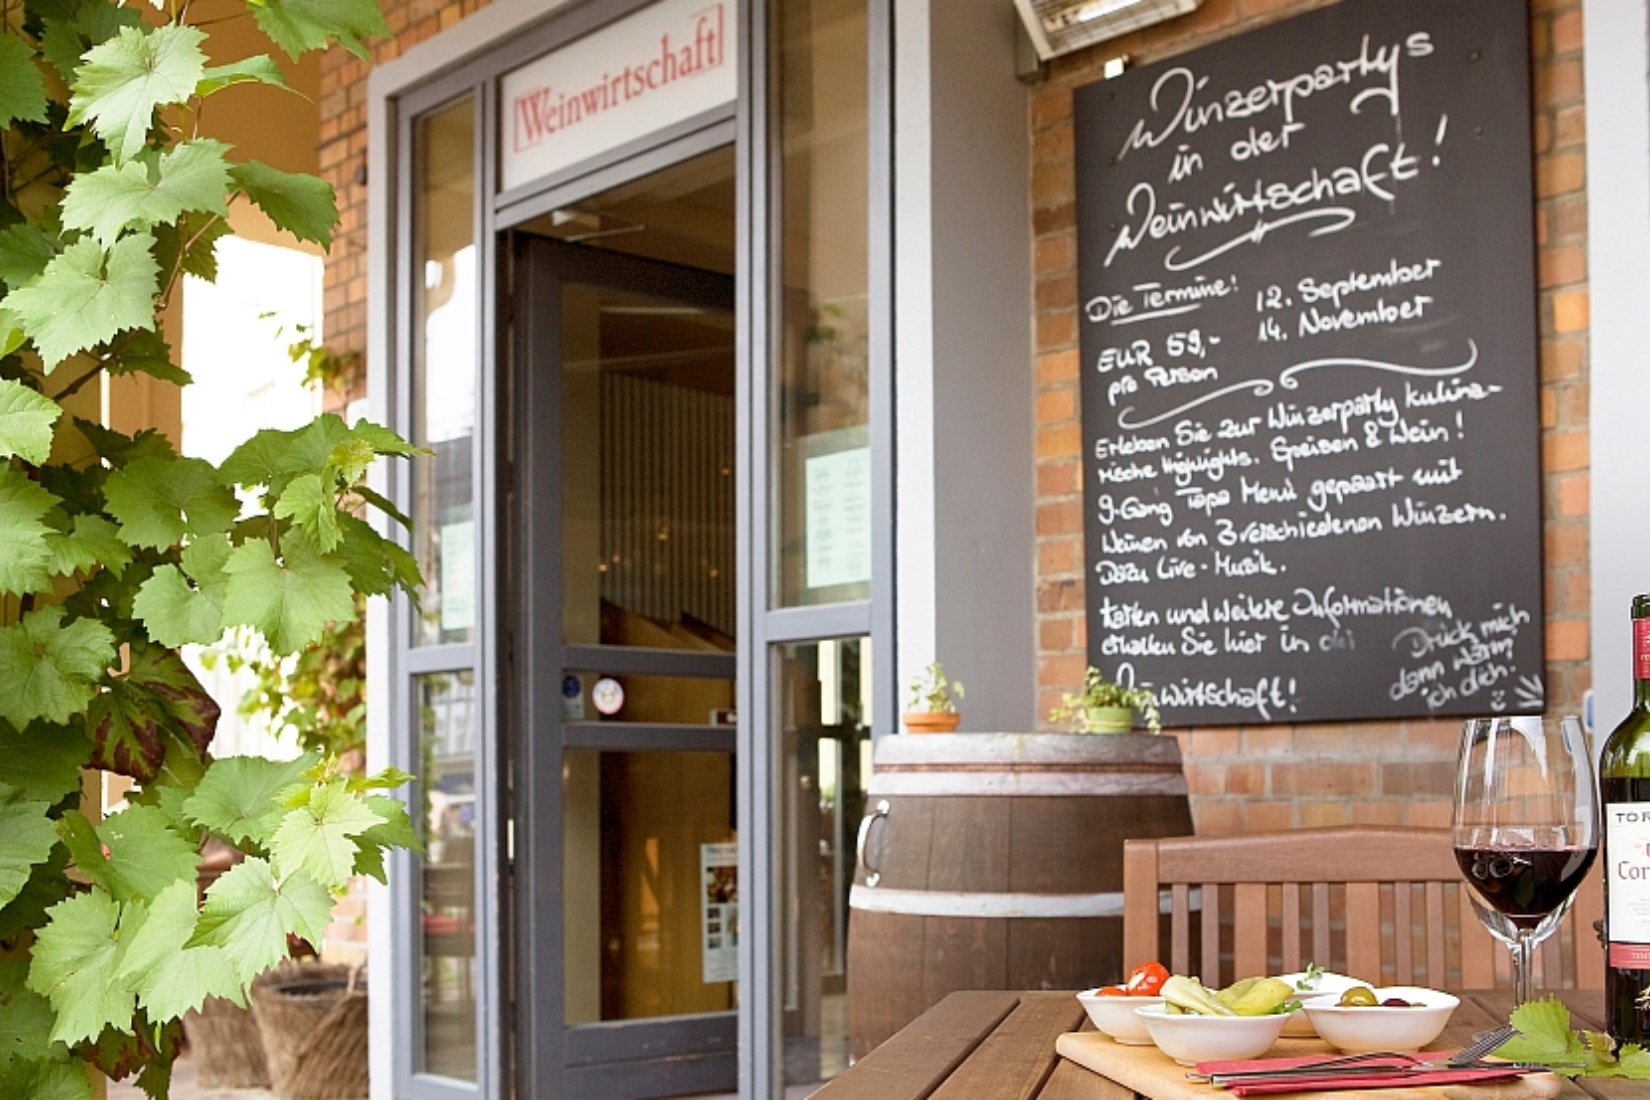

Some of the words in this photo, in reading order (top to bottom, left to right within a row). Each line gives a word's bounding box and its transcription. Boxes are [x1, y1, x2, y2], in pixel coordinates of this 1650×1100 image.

[516, 16, 717, 143] Weinwirtschaft
[1168, 145, 1203, 184] in
[1230, 122, 1306, 161] der
[1085, 294, 1134, 322] Die
[1256, 285, 1292, 312] 12.
[1297, 259, 1441, 306] September
[1257, 316, 1288, 342] 14.
[1298, 294, 1434, 337] November
[1097, 340, 1153, 372] EUR
[1108, 375, 1138, 406] pro
[1144, 365, 1218, 393] Person
[1095, 435, 1170, 459] Erleben
[1174, 419, 1212, 446] Sie
[1267, 386, 1399, 434] Winzerparty
[1097, 460, 1158, 484] rische
[1270, 436, 1358, 472] Speisen
[1363, 420, 1383, 448] &
[1306, 467, 1404, 512] gepaart
[1412, 456, 1463, 485] mit
[1102, 529, 1168, 554] Weinen
[1177, 527, 1208, 547] von
[1239, 510, 1383, 544] verschiedenen
[1095, 560, 1149, 586] Dazu
[1166, 597, 1211, 625] und
[1214, 591, 1290, 622] weitere
[1292, 586, 1453, 629] Informationen
[1480, 603, 1531, 637] mich
[1101, 633, 1176, 656] erhalten
[1181, 626, 1218, 656] Sie
[1224, 627, 1267, 653] hier
[1280, 624, 1310, 653] in
[1389, 660, 1445, 701] dann
[1421, 686, 1458, 709] ich
